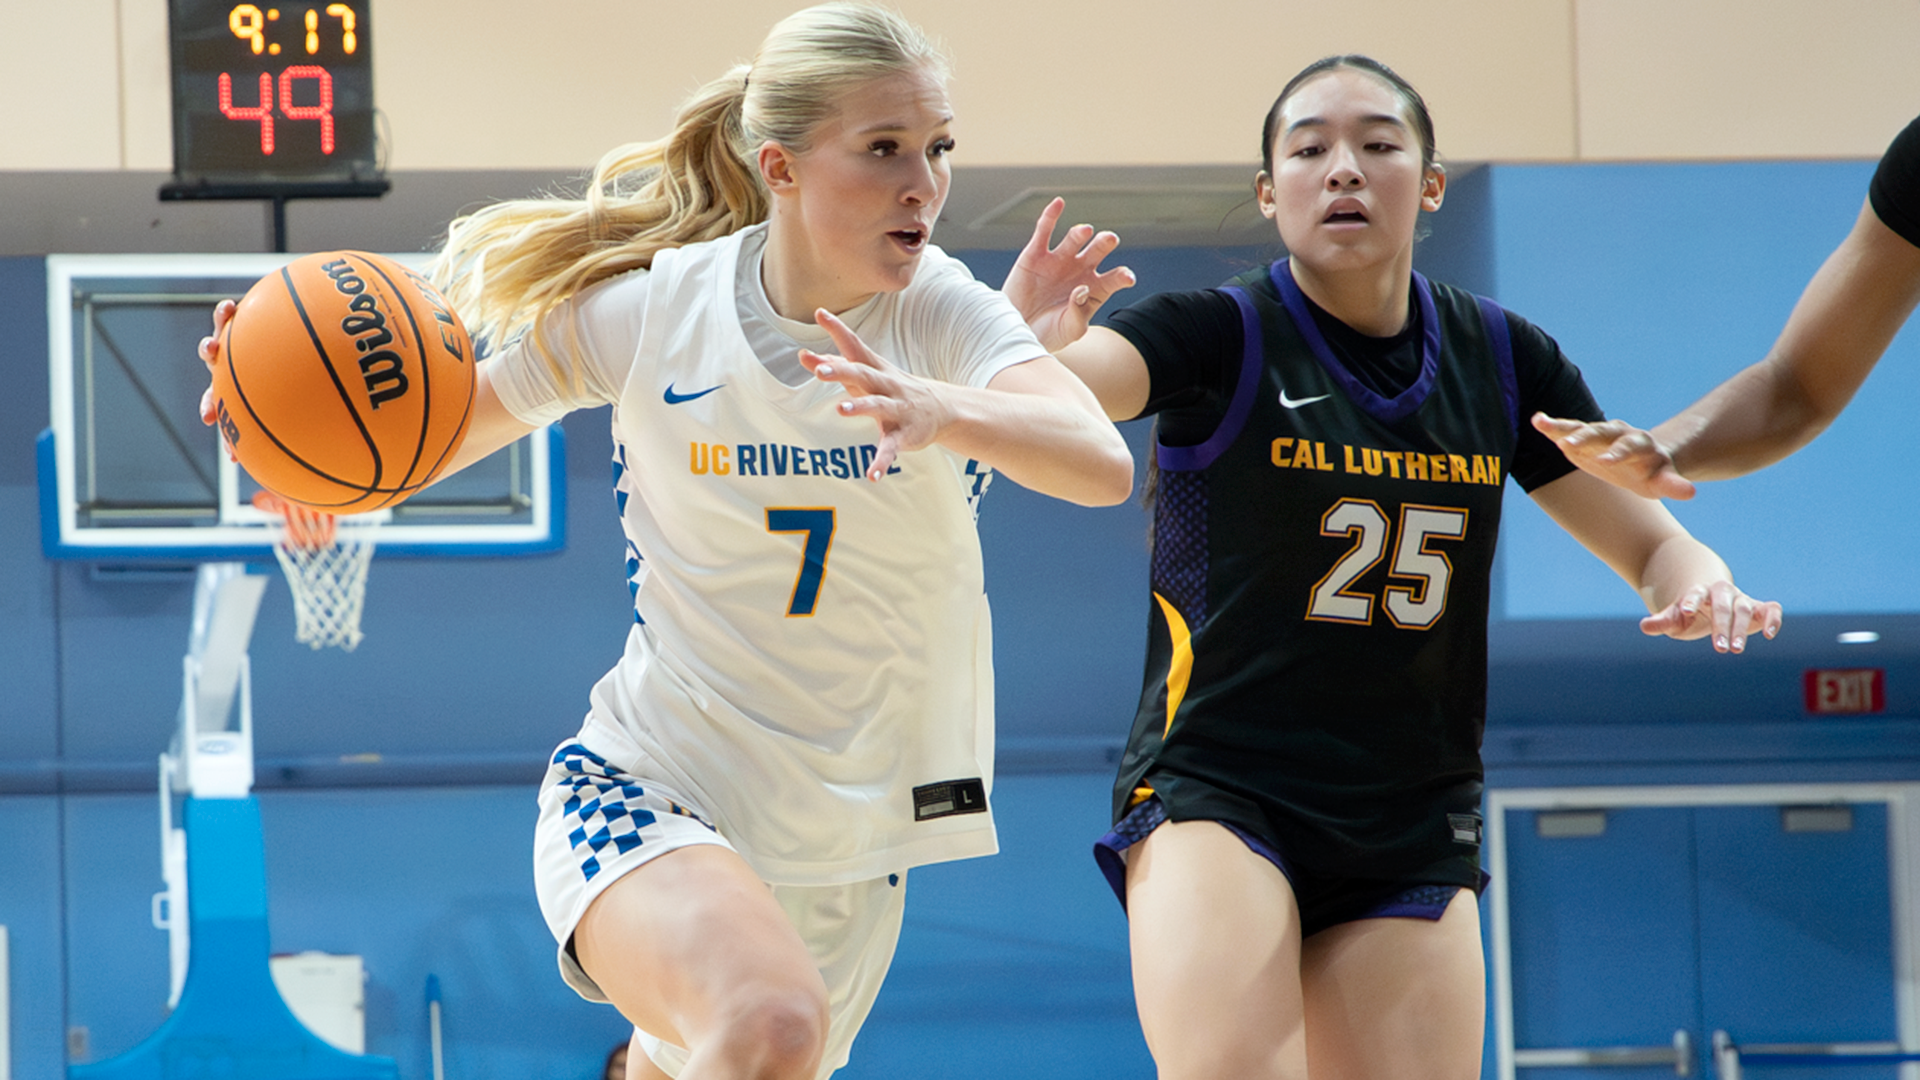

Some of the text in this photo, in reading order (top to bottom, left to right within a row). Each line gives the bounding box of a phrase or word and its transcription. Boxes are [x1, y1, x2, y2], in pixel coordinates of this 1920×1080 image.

[229, 3, 357, 55] 9:17
[218, 65, 335, 155] 49
[320, 257, 410, 412] Wilson
[690, 442, 731, 476] UC
[1270, 436, 1501, 486] CAL LUTHERAN
[763, 506, 838, 618] 7
[1304, 496, 1470, 631] 25
[1818, 670, 1876, 711] EXIT
[962, 789, 973, 804] L
